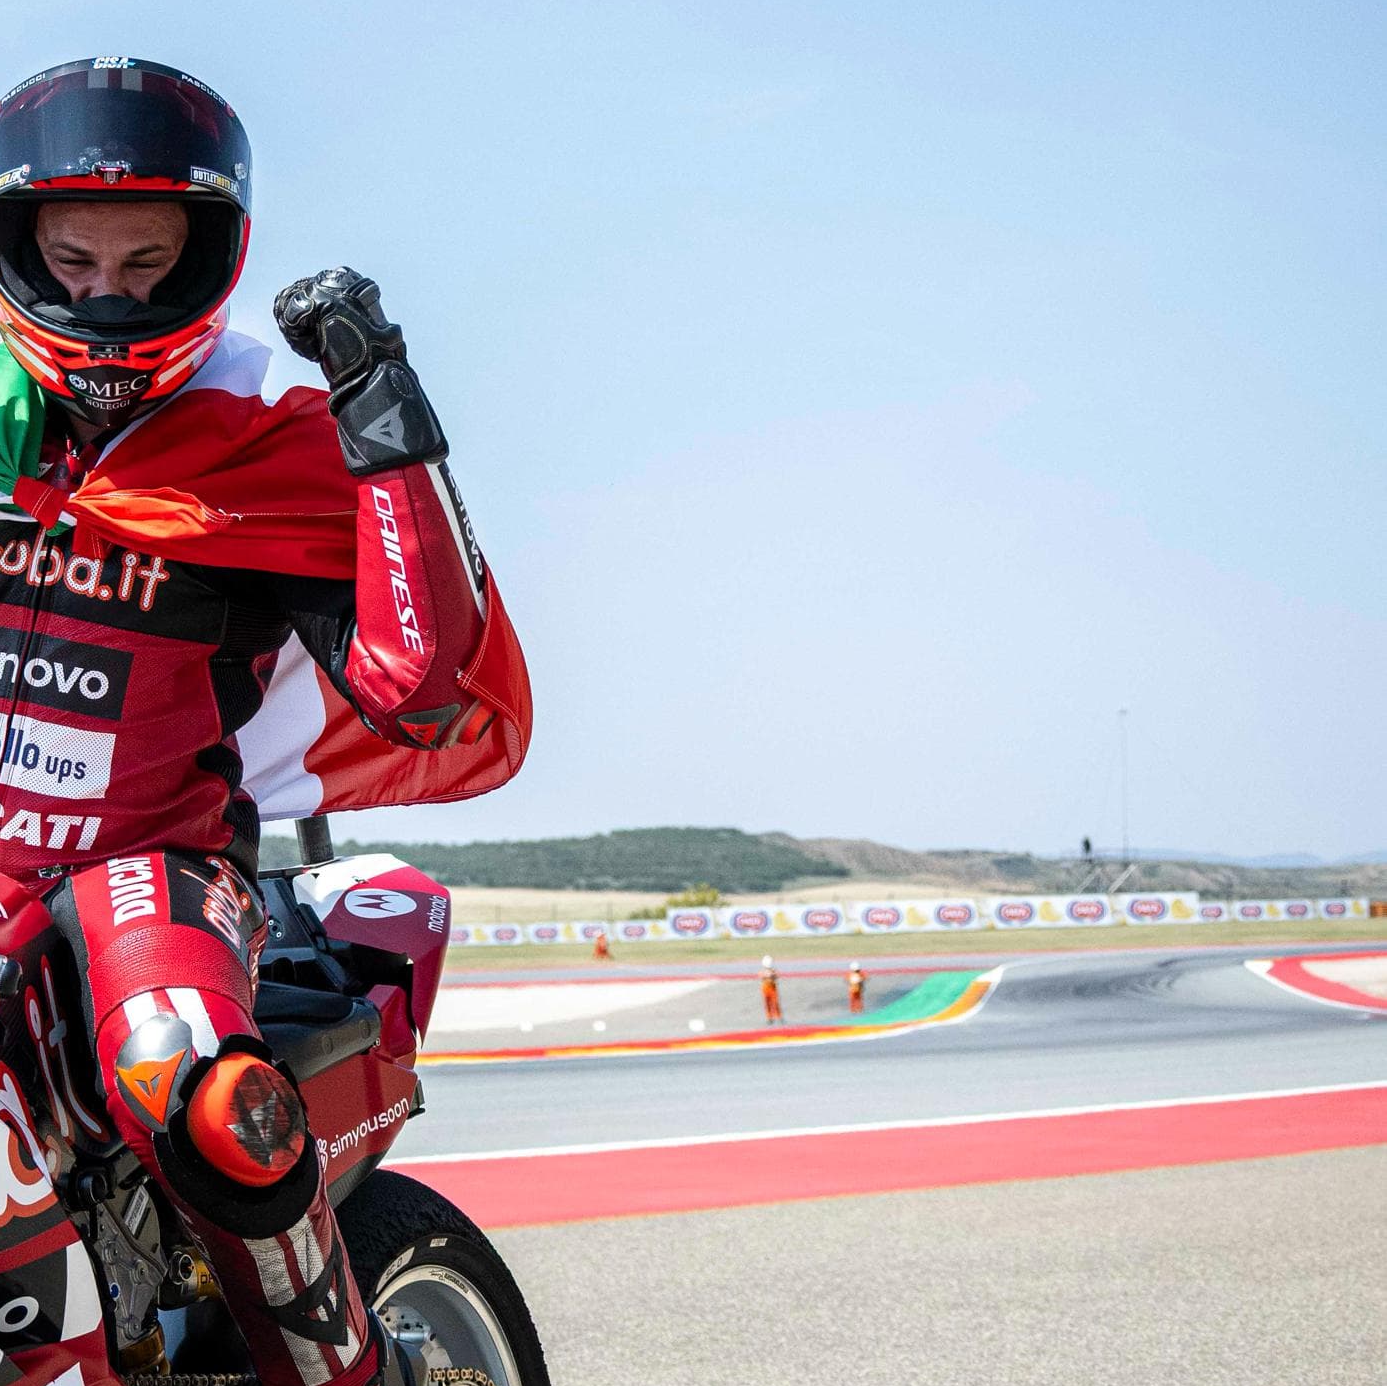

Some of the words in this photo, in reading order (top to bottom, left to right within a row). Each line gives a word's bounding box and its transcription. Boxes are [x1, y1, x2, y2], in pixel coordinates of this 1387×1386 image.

[0, 73, 47, 103] PASCUCCI
[180, 73, 226, 106] PASCUCCI
[85, 399, 131, 411] NOLEGGI
[371, 485, 425, 655] DAINESE
[44, 754, 88, 785] ups
[426, 895, 448, 934] motorola
[329, 1097, 410, 1159] simyousoon
